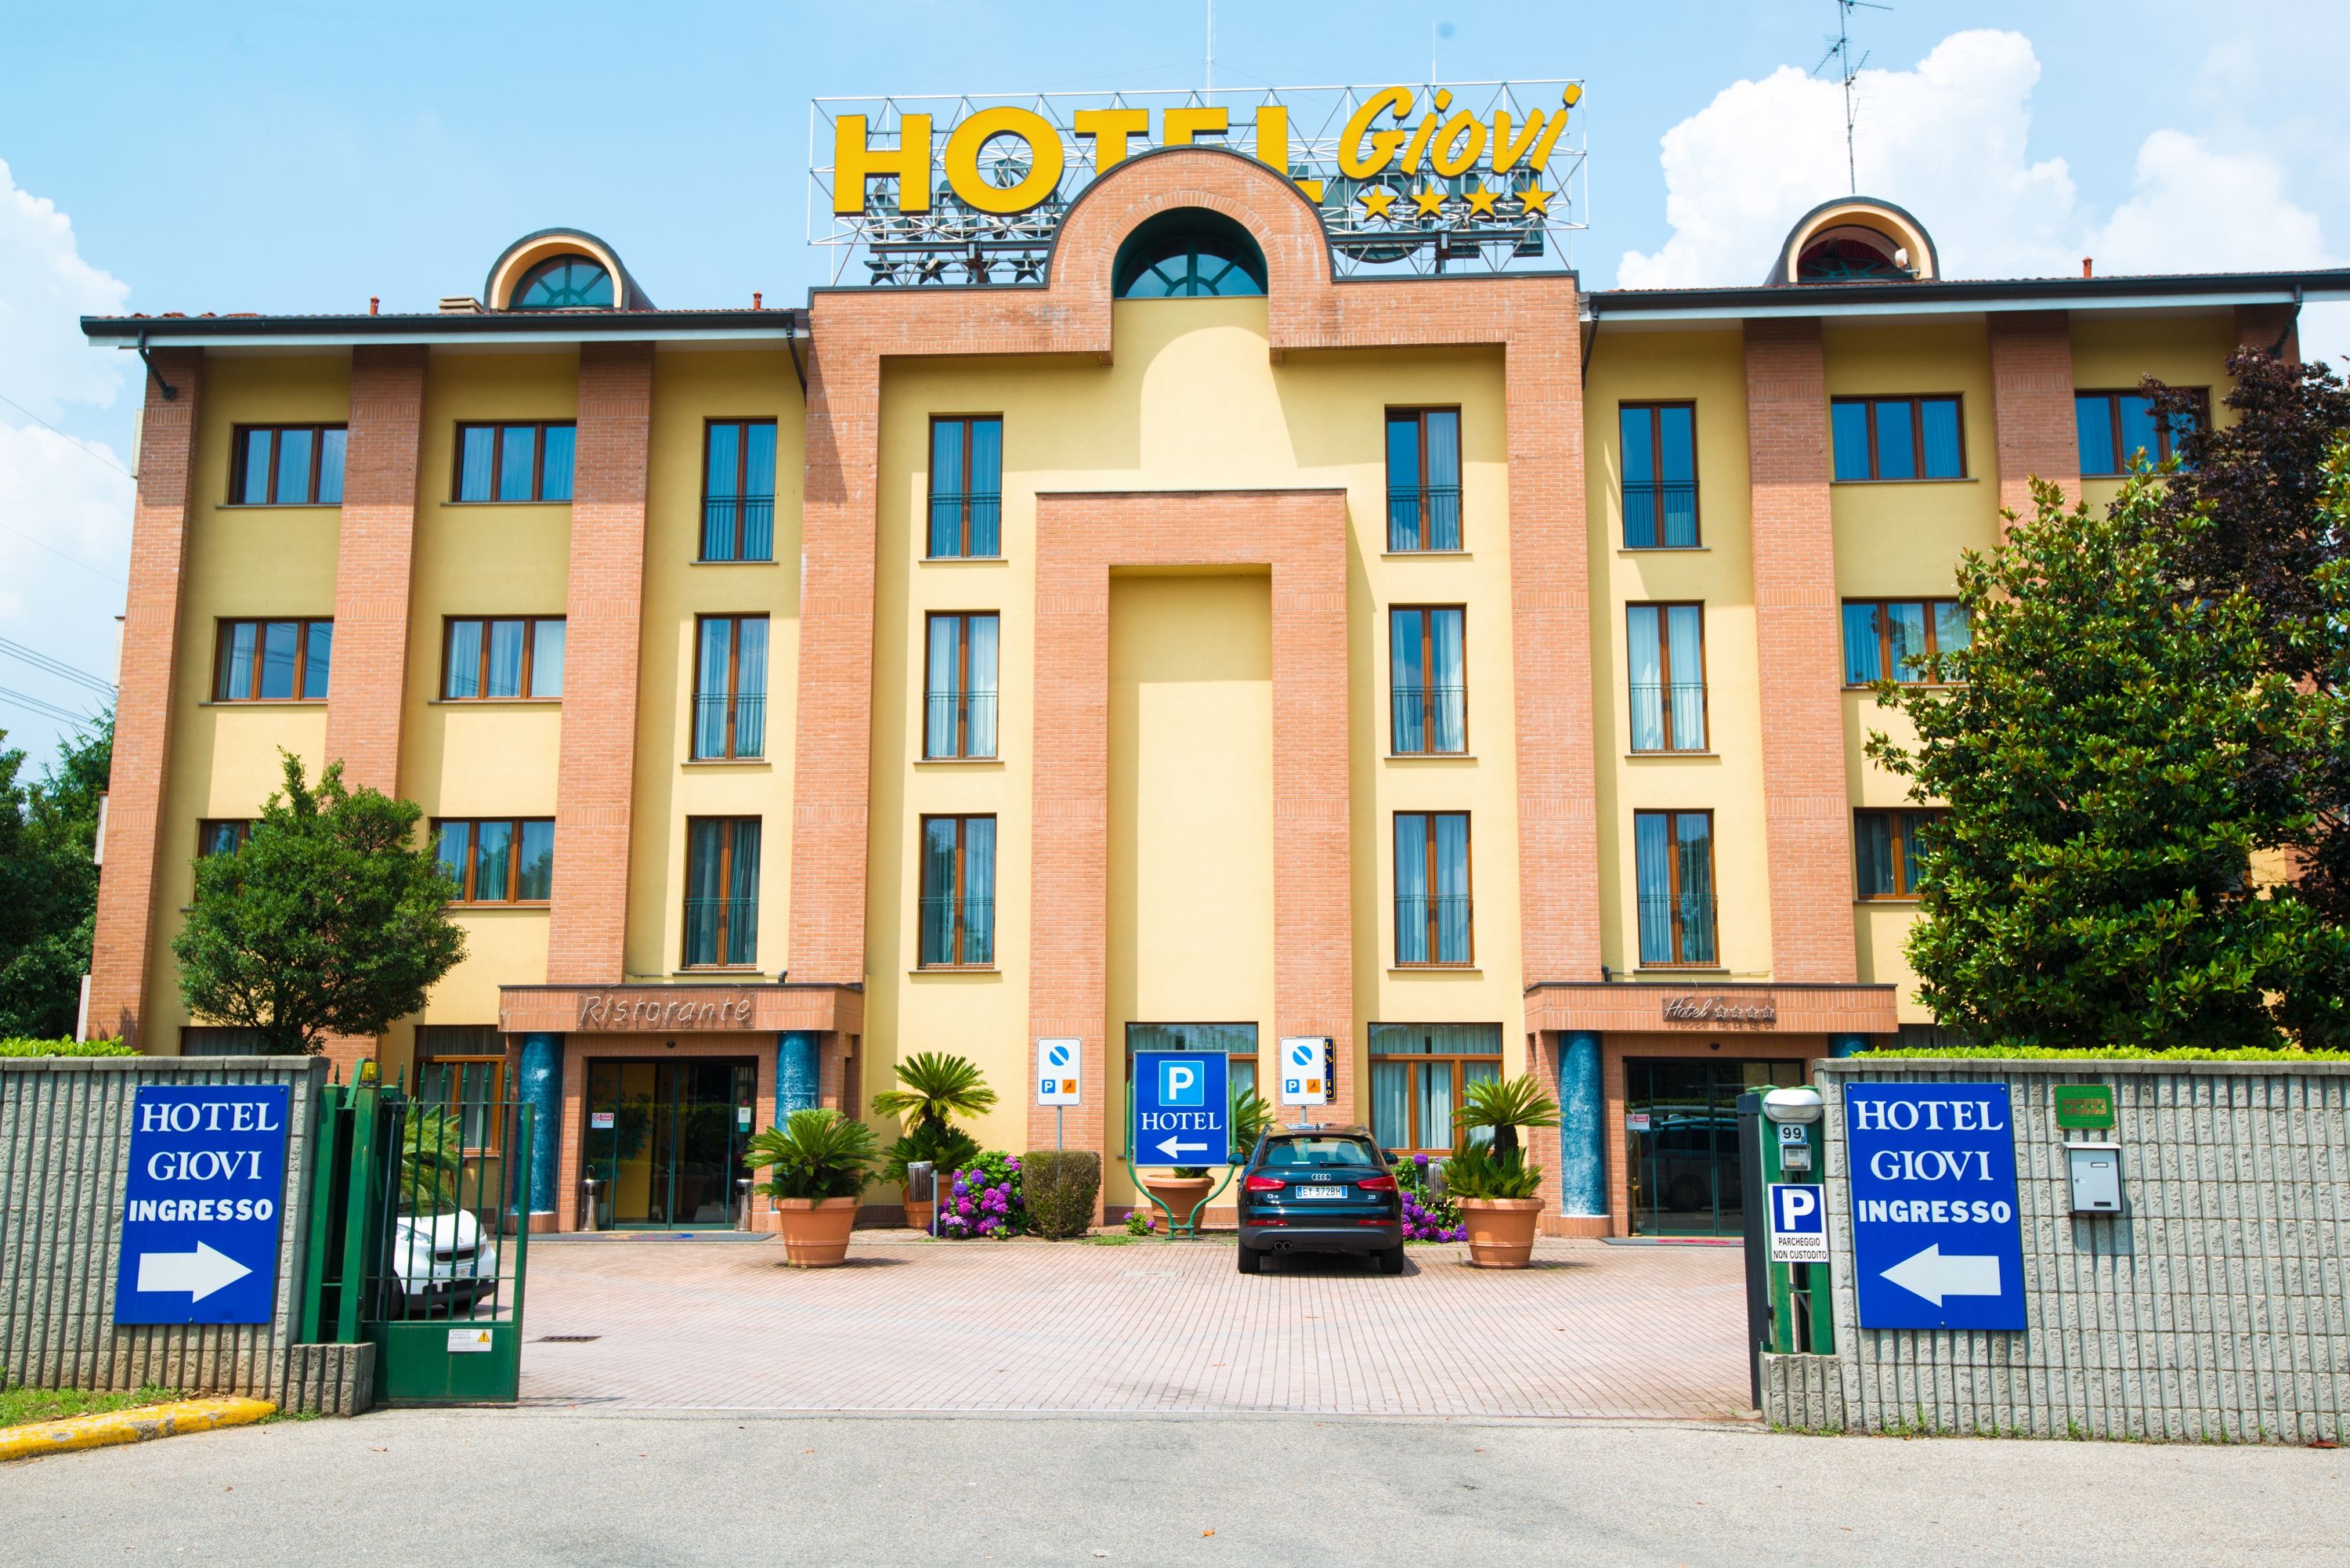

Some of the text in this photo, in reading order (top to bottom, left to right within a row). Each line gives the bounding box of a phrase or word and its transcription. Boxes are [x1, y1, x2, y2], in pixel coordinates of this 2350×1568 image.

[1338, 84, 1582, 180] Giovi
[580, 994, 750, 1021] Ristorante
[1665, 997, 1712, 1018] Hotel
[1044, 1081, 1054, 1093] P
[1169, 1067, 1194, 1100] P
[1288, 1080, 1297, 1093] P
[140, 1102, 279, 1133] HOTEL
[1141, 1112, 1222, 1130] HOTEL
[1853, 1100, 2004, 1131] HOTEL
[1782, 1127, 1802, 1140] 99
[147, 1151, 262, 1181] GIOVI
[1871, 1150, 1994, 1181] GIOVI
[1303, 1187, 1341, 1196] EY 372BH
[128, 1199, 273, 1222] INGRESSO
[1782, 1189, 1815, 1230] P
[1858, 1200, 2012, 1223] INGRESSO
[1778, 1237, 1820, 1246] PARCHEGGIO
[1773, 1250, 1827, 1259] NON CUSTODITO
